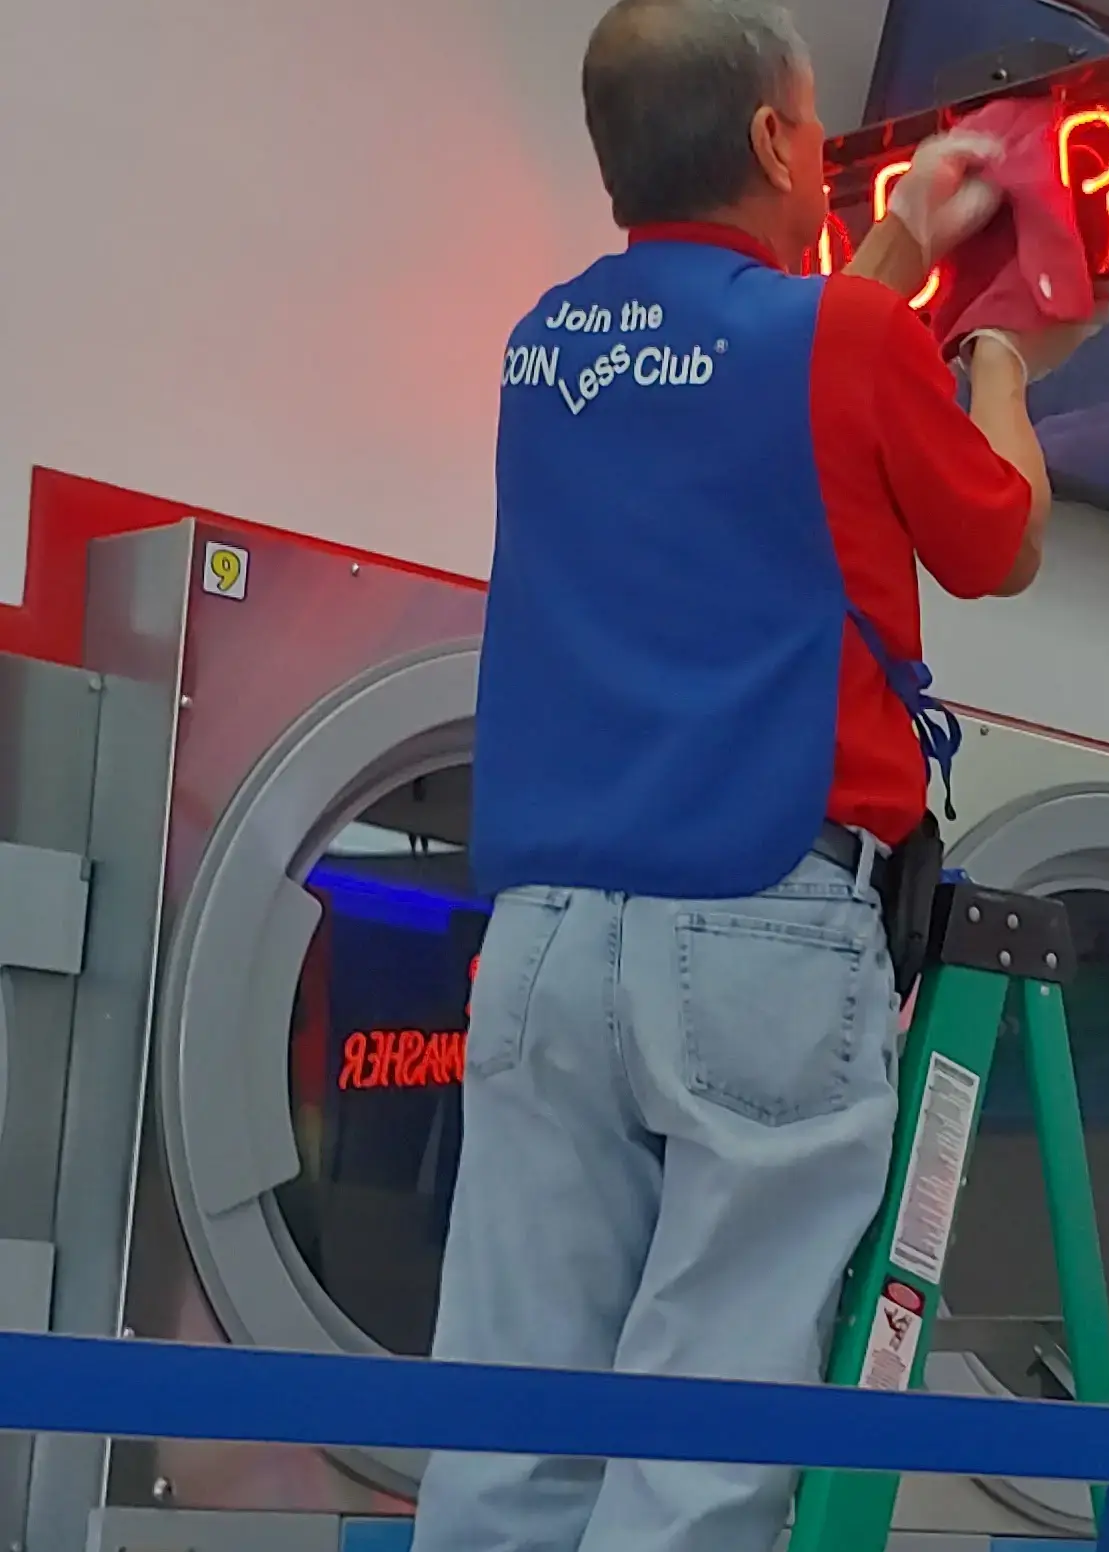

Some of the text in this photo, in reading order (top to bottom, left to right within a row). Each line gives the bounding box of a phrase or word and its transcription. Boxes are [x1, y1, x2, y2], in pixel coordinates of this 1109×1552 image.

[546, 298, 663, 333] Join the
[558, 342, 631, 415] Less
[210, 549, 241, 591] 9
